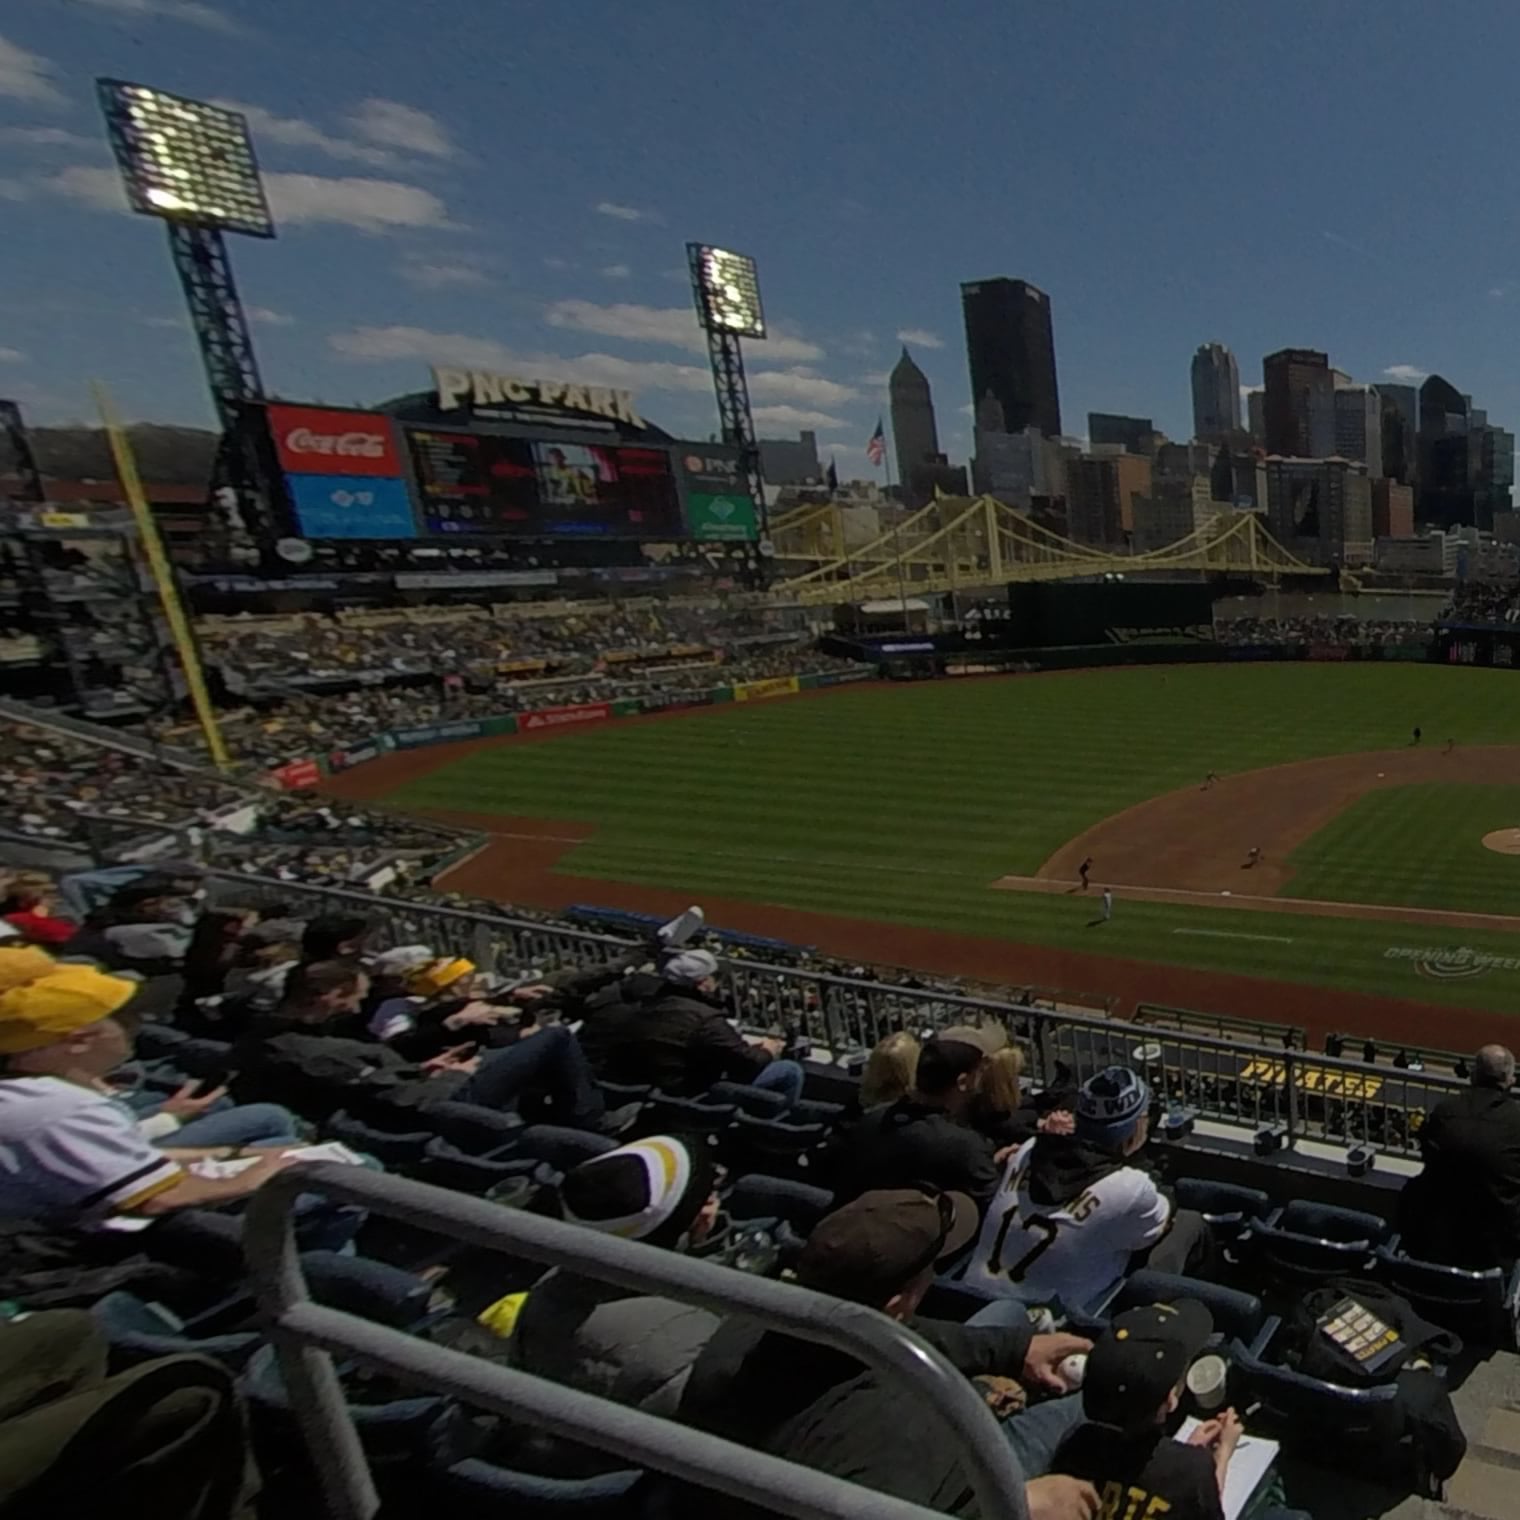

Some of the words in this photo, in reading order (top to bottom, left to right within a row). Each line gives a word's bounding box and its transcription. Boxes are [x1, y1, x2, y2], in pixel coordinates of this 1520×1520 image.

[433, 367, 531, 412] PNC
[538, 380, 648, 431] PARK
[987, 1205, 1058, 1282] 17
